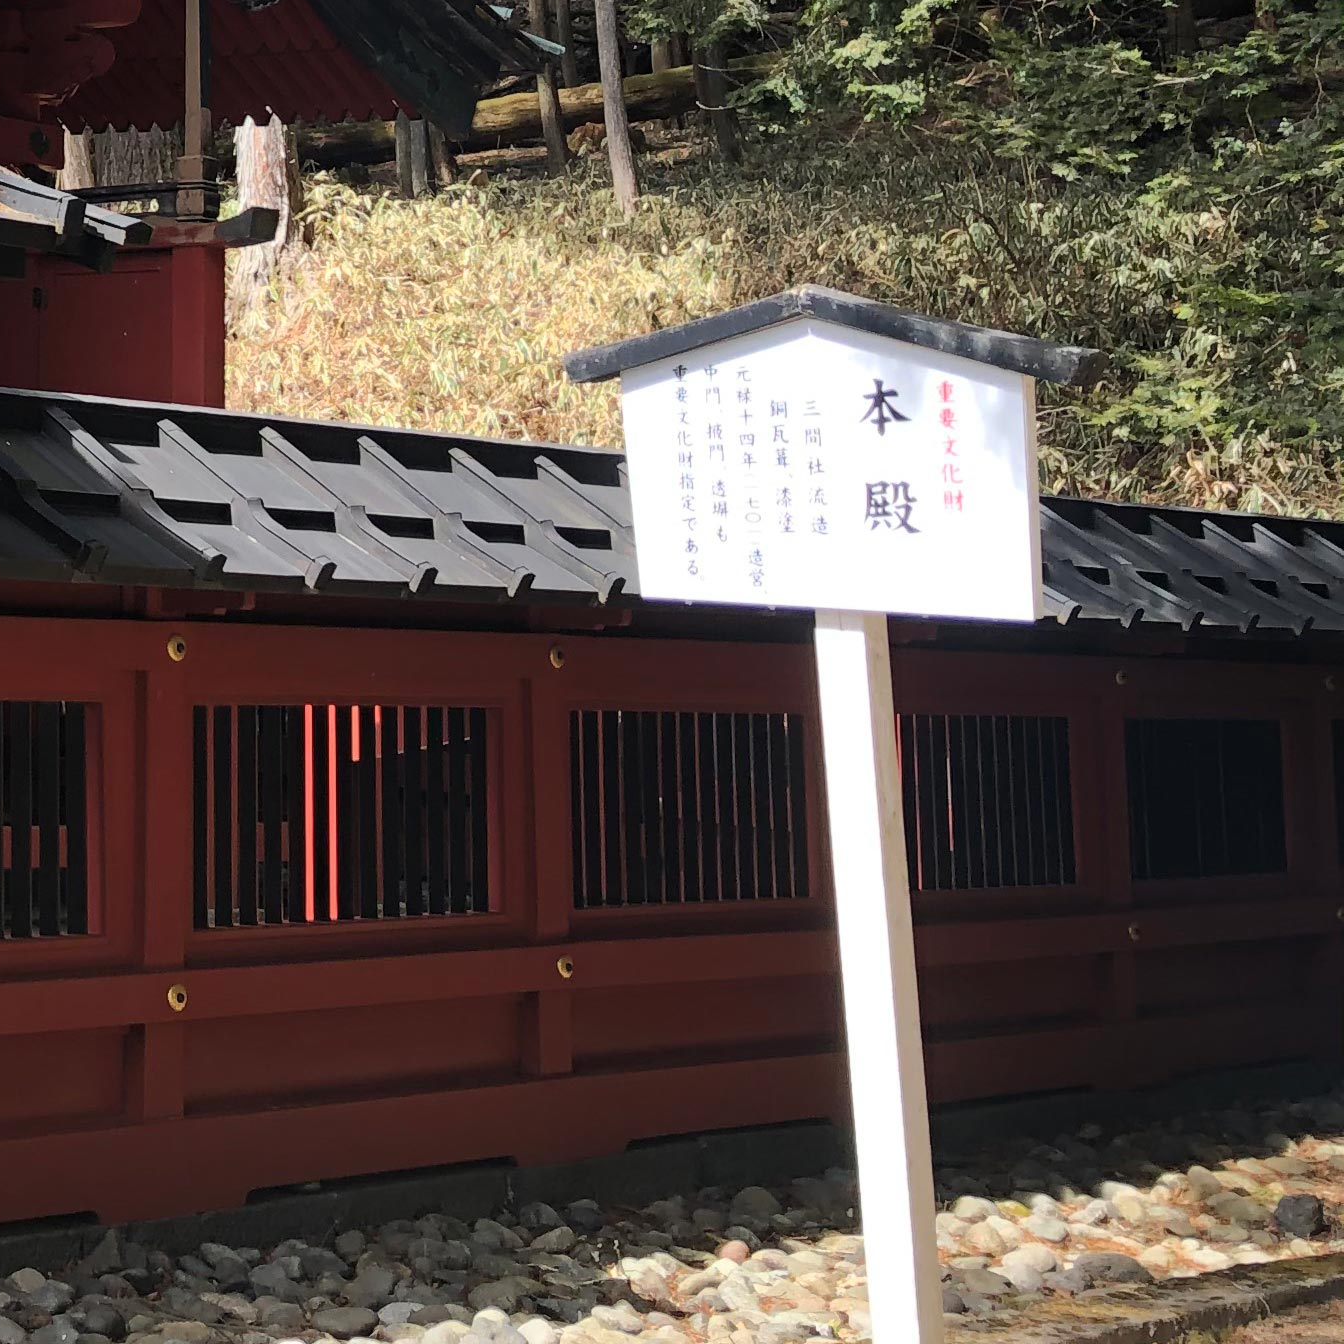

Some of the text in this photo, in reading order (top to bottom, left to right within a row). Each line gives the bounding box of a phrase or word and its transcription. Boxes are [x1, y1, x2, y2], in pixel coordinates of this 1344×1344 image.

[803, 400, 830, 536] 三間社流造
[859, 378, 923, 534] 本殿
[936, 380, 964, 512] 重要文化財
